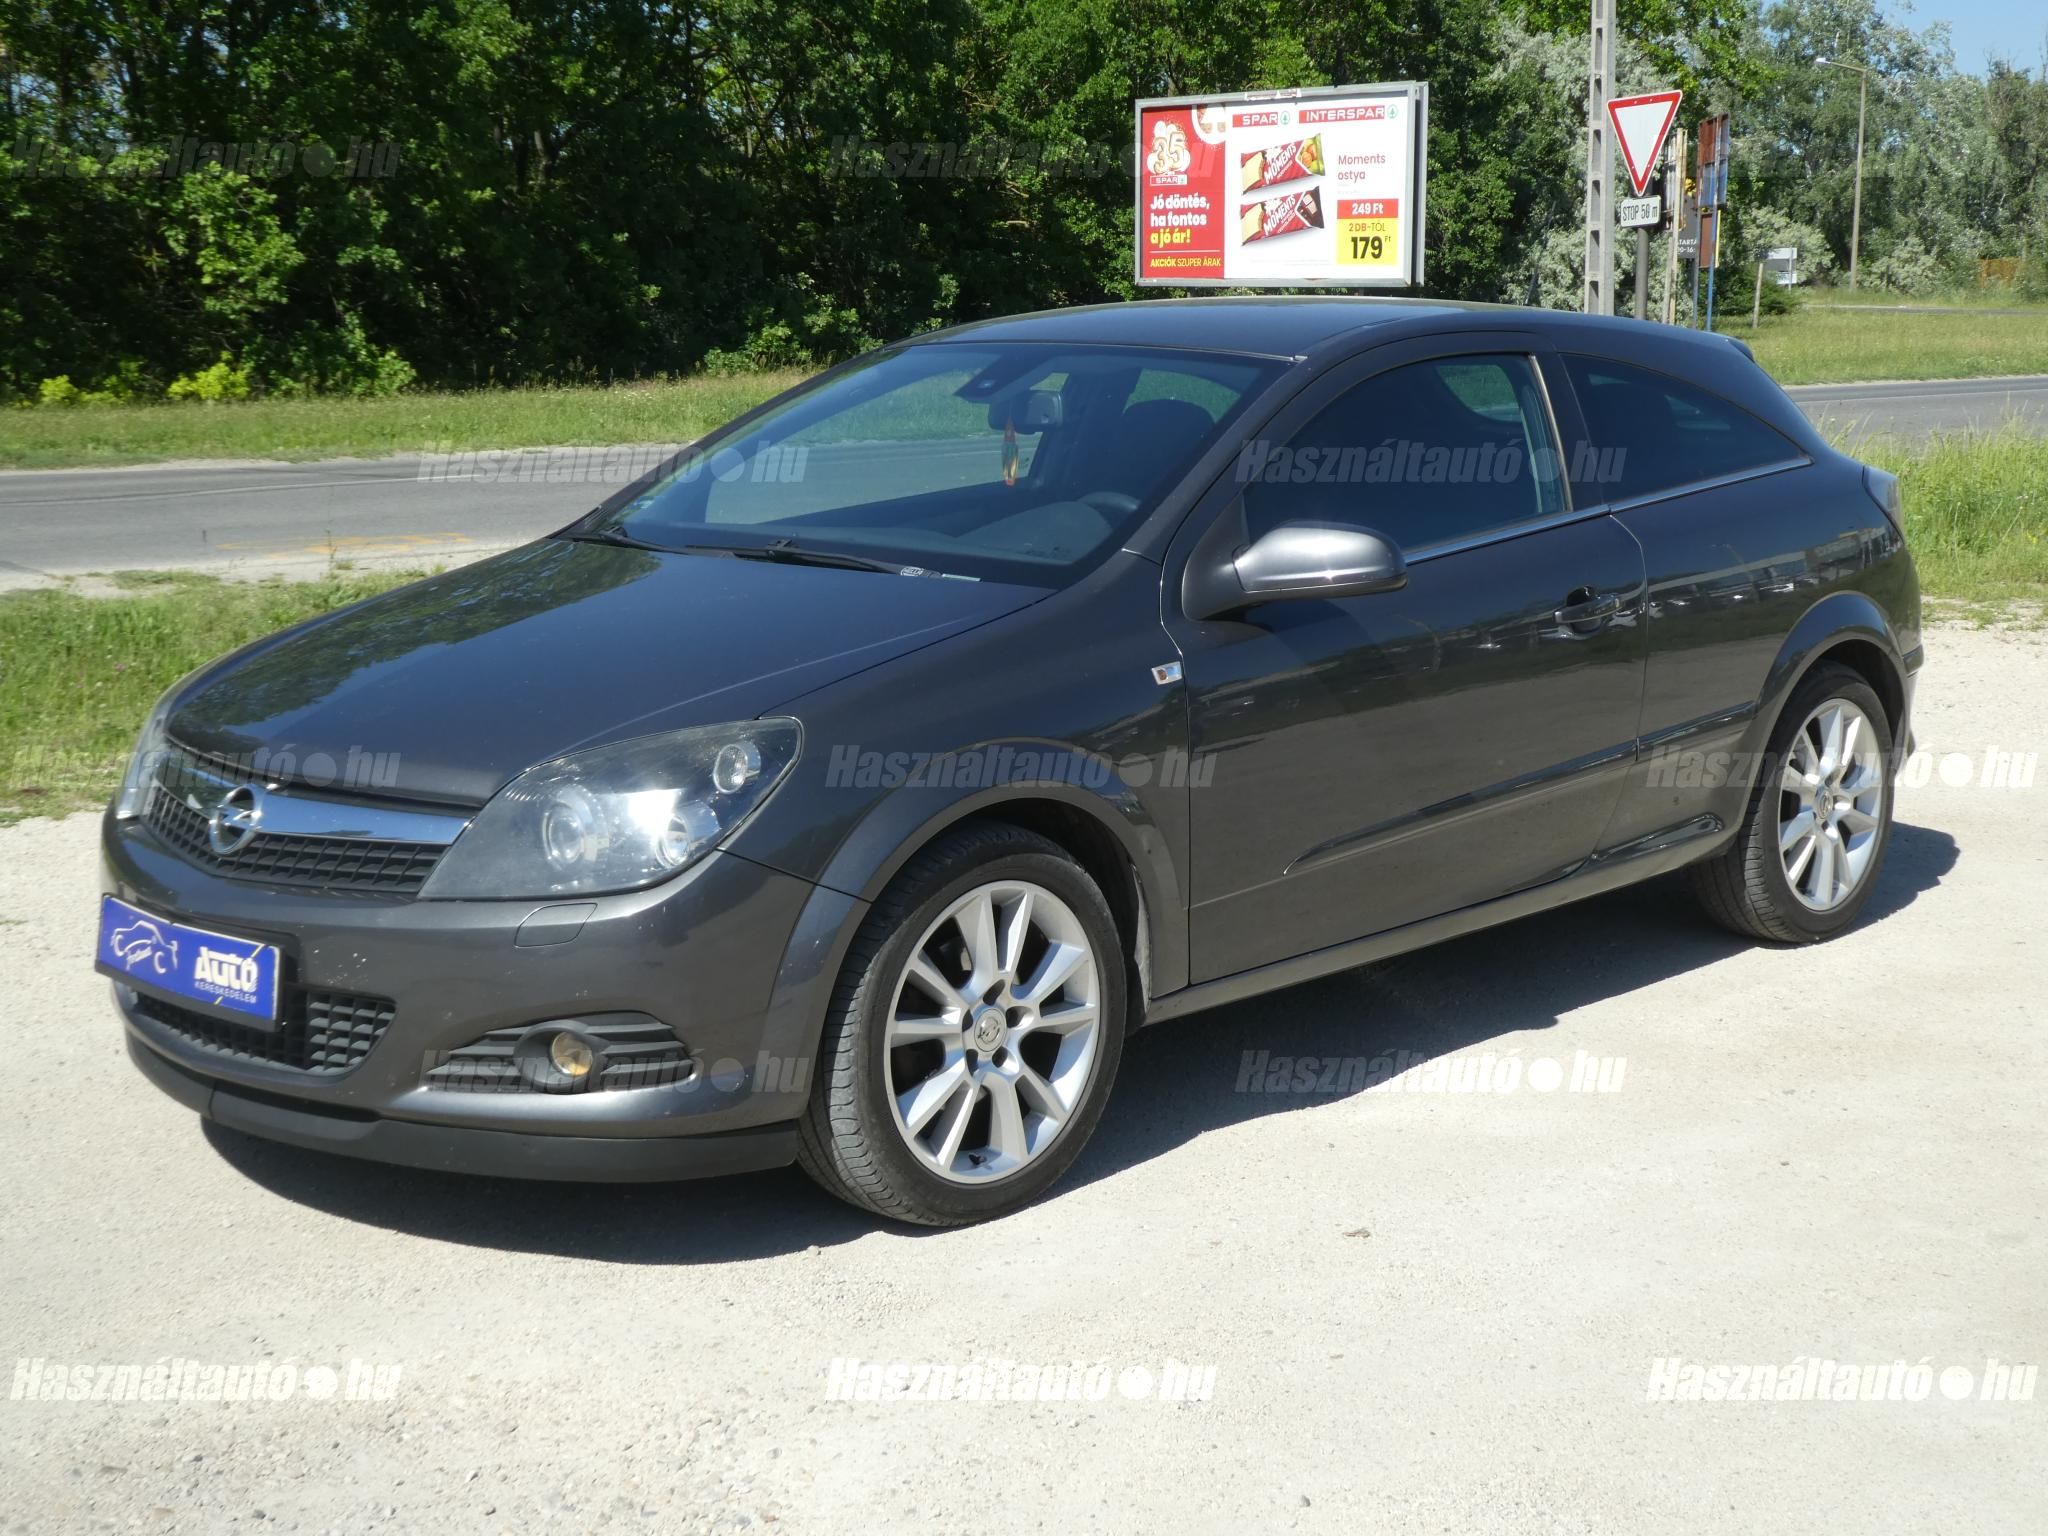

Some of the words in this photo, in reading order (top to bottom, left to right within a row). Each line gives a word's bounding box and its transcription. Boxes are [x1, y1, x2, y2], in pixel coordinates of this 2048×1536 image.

[1242, 113, 1278, 126] SPAR
[1306, 106, 1385, 122] INTERSPAR
[1338, 153, 1386, 165] Moments
[1155, 177, 1178, 185] SPAR
[1337, 170, 1366, 183] ostya
[1150, 193, 1164, 210] Jó
[1165, 192, 1210, 210] döntés,
[1352, 203, 1372, 215] 249
[1373, 203, 1384, 214] Ft
[1622, 205, 1639, 222] STOP
[1641, 203, 1650, 219] 50
[1651, 206, 1658, 217] m
[1151, 212, 1166, 227] ha
[1167, 211, 1207, 227] fontos
[1150, 232, 1159, 244] a
[1159, 228, 1171, 248] jó
[1172, 228, 1191, 244] ár!
[1351, 235, 1382, 259] 179
[1150, 256, 1176, 268] AKCIÓK
[1177, 258, 1202, 267] SZUPER
[1203, 256, 1221, 267] ÁRAK
